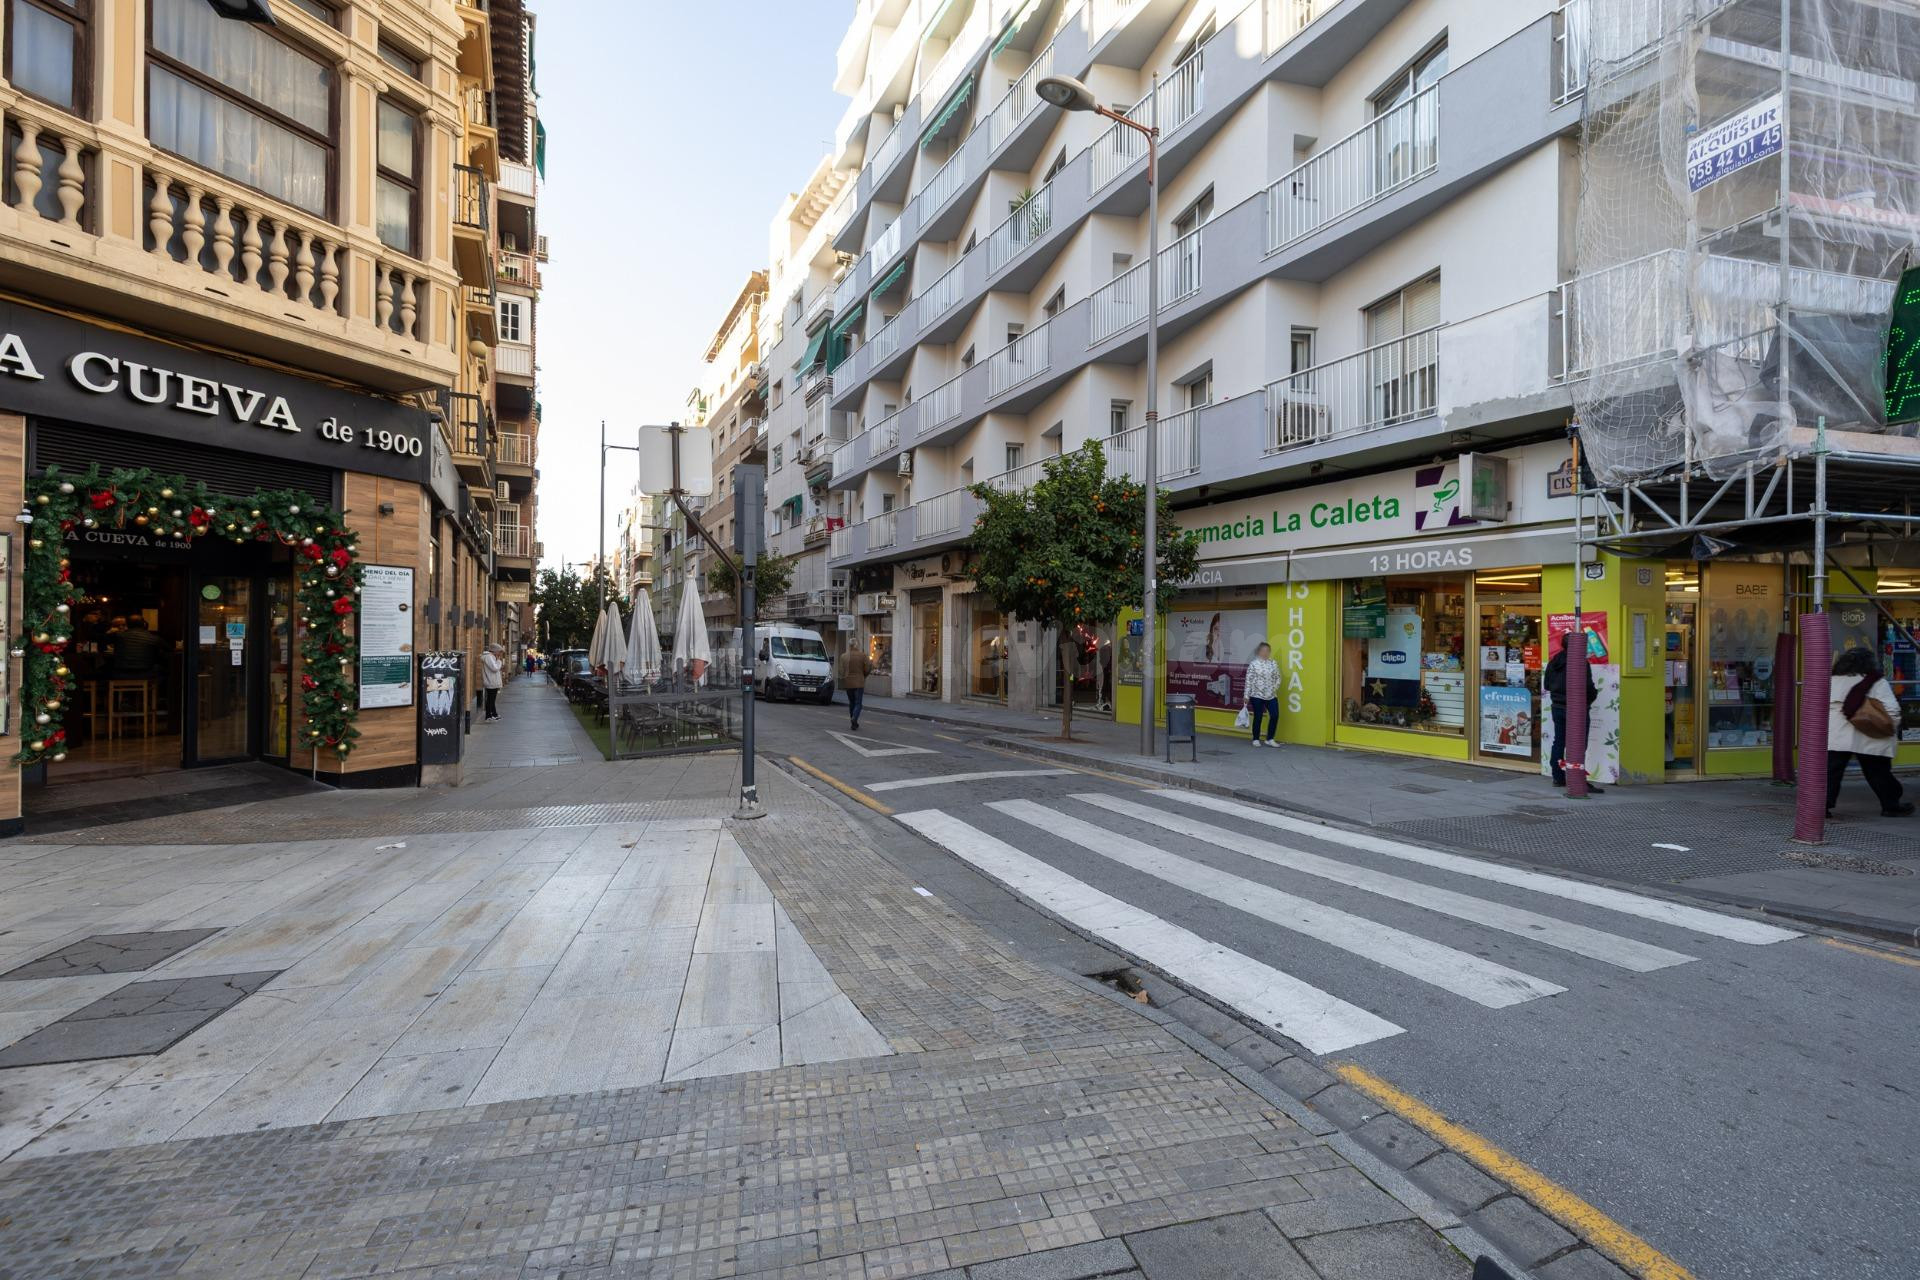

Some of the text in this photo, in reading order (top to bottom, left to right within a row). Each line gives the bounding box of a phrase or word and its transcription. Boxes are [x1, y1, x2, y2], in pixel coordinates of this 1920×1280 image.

[1687, 108, 1777, 164] ALQUISUR
[1690, 114, 1750, 149] andamios
[1690, 125, 1780, 183] 958 42 01 45
[1695, 146, 1775, 188] www.alquisur.com
[0, 333, 423, 457] A CUEVA de 1900
[1177, 495, 1401, 544] armacia La Caleta
[85, 531, 149, 546] CUEVA
[155, 540, 167, 548] de
[169, 541, 192, 550] 1900
[1369, 547, 1473, 573] 13 HORAS
[1735, 584, 1769, 595] BABE
[1841, 611, 1866, 622] Bion3
[1287, 607, 1305, 713] HORAS
[1382, 651, 1406, 663] chicco
[1484, 690, 1528, 703] efemás
